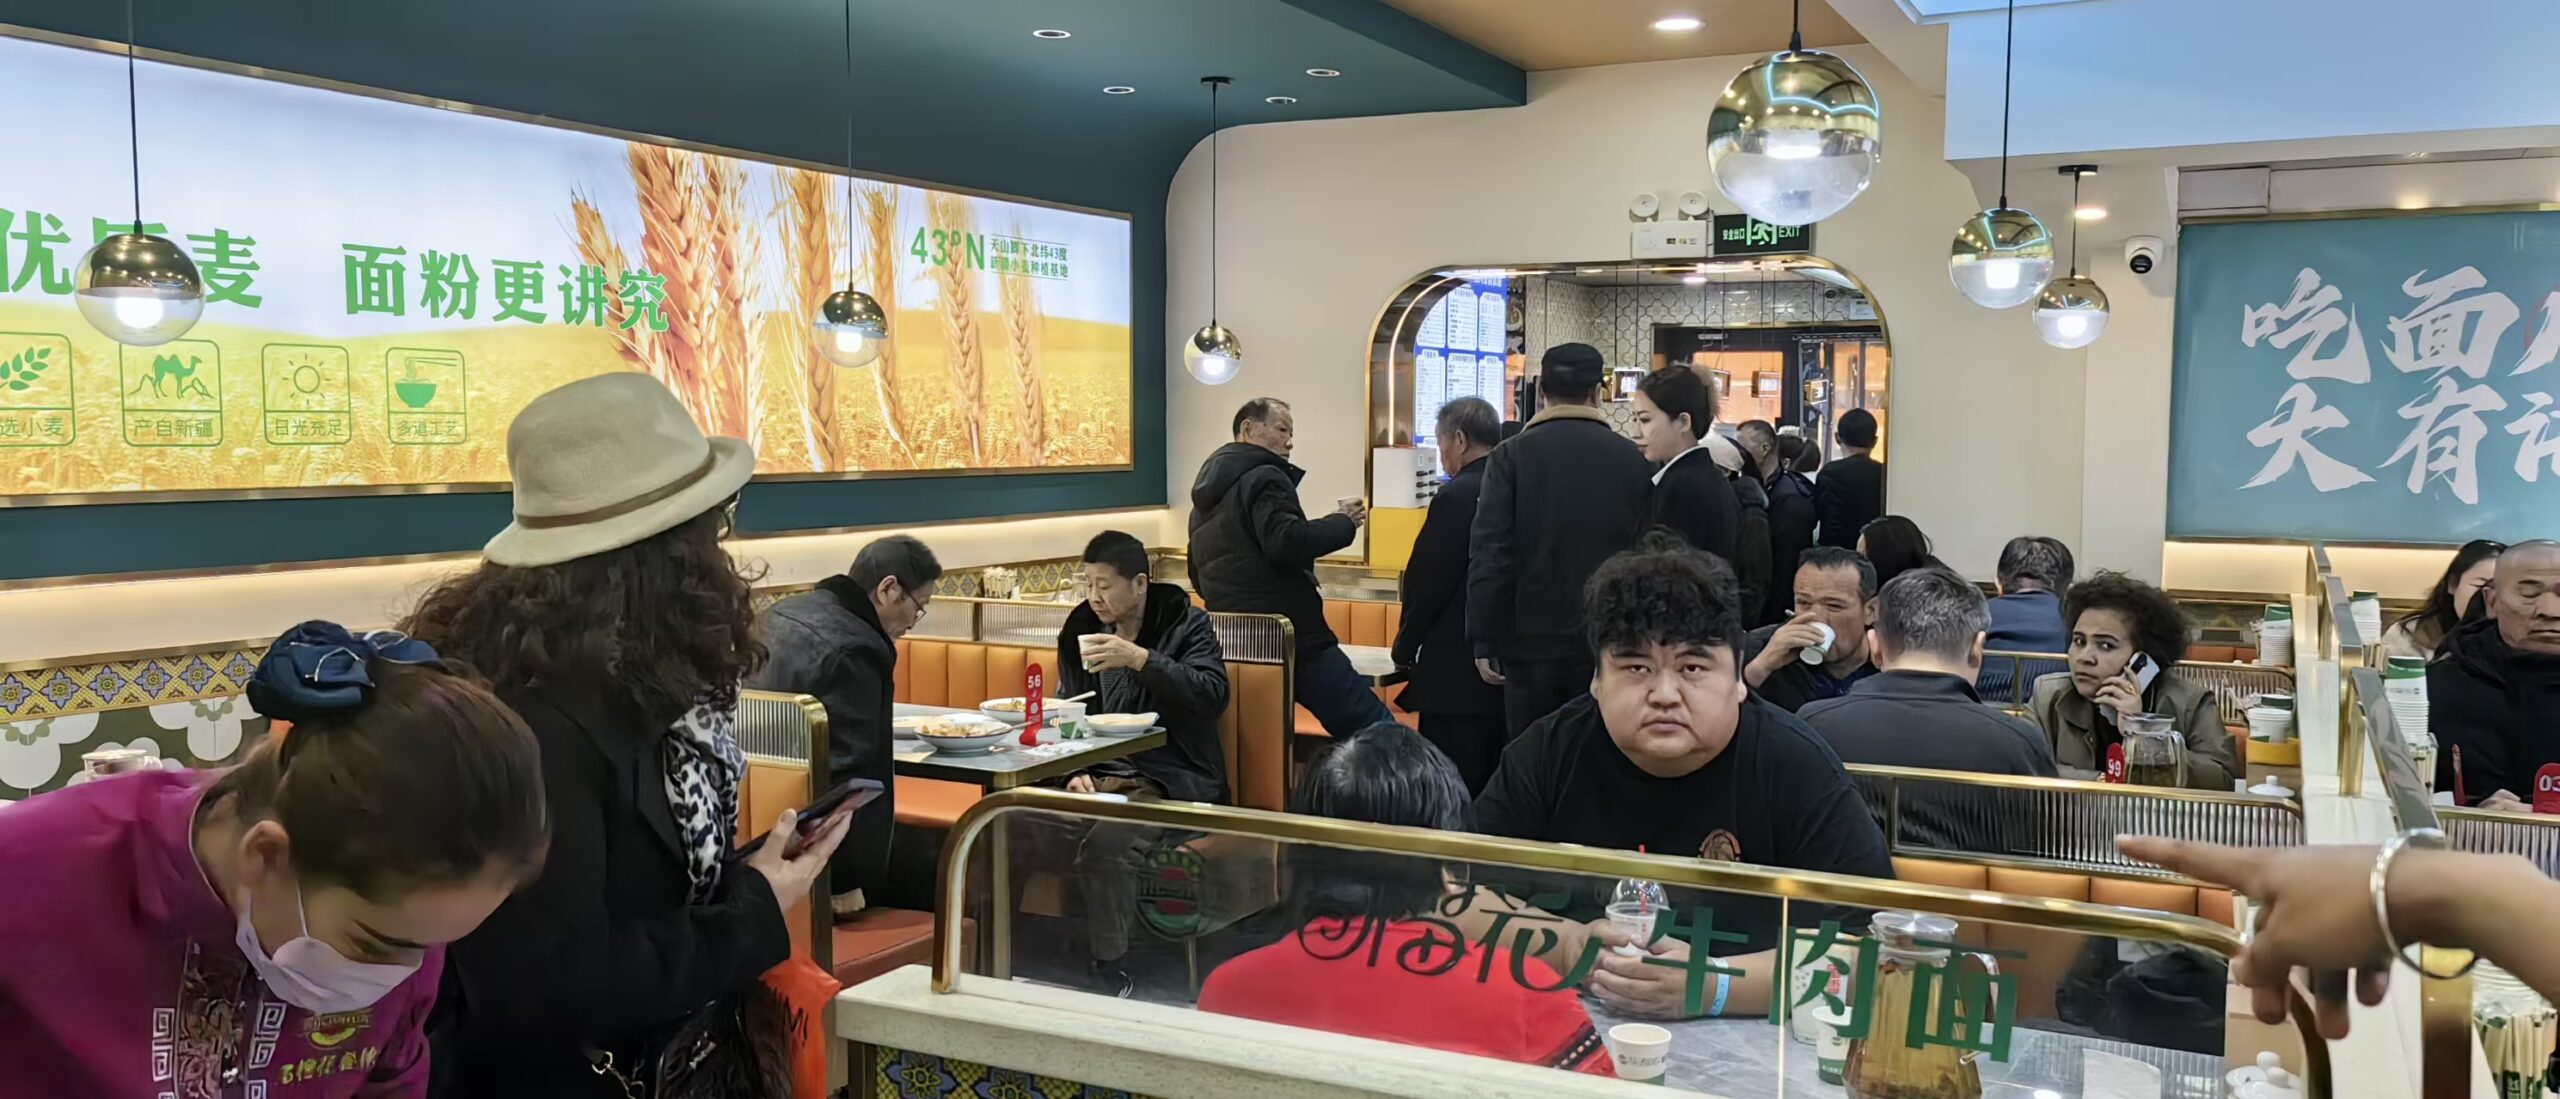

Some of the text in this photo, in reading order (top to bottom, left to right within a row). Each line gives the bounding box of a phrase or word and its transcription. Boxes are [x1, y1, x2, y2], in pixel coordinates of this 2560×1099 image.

[1722, 228, 1745, 241] 安全出口
[1778, 225, 1800, 239] EXIT
[0, 208, 670, 332] 优麦 面粉更讲究
[133, 417, 214, 438] 产自新疆
[275, 418, 343, 437] 日光充足
[397, 420, 459, 438] 多道工艺
[1027, 674, 1042, 689] 56
[2107, 758, 2121, 777] 99
